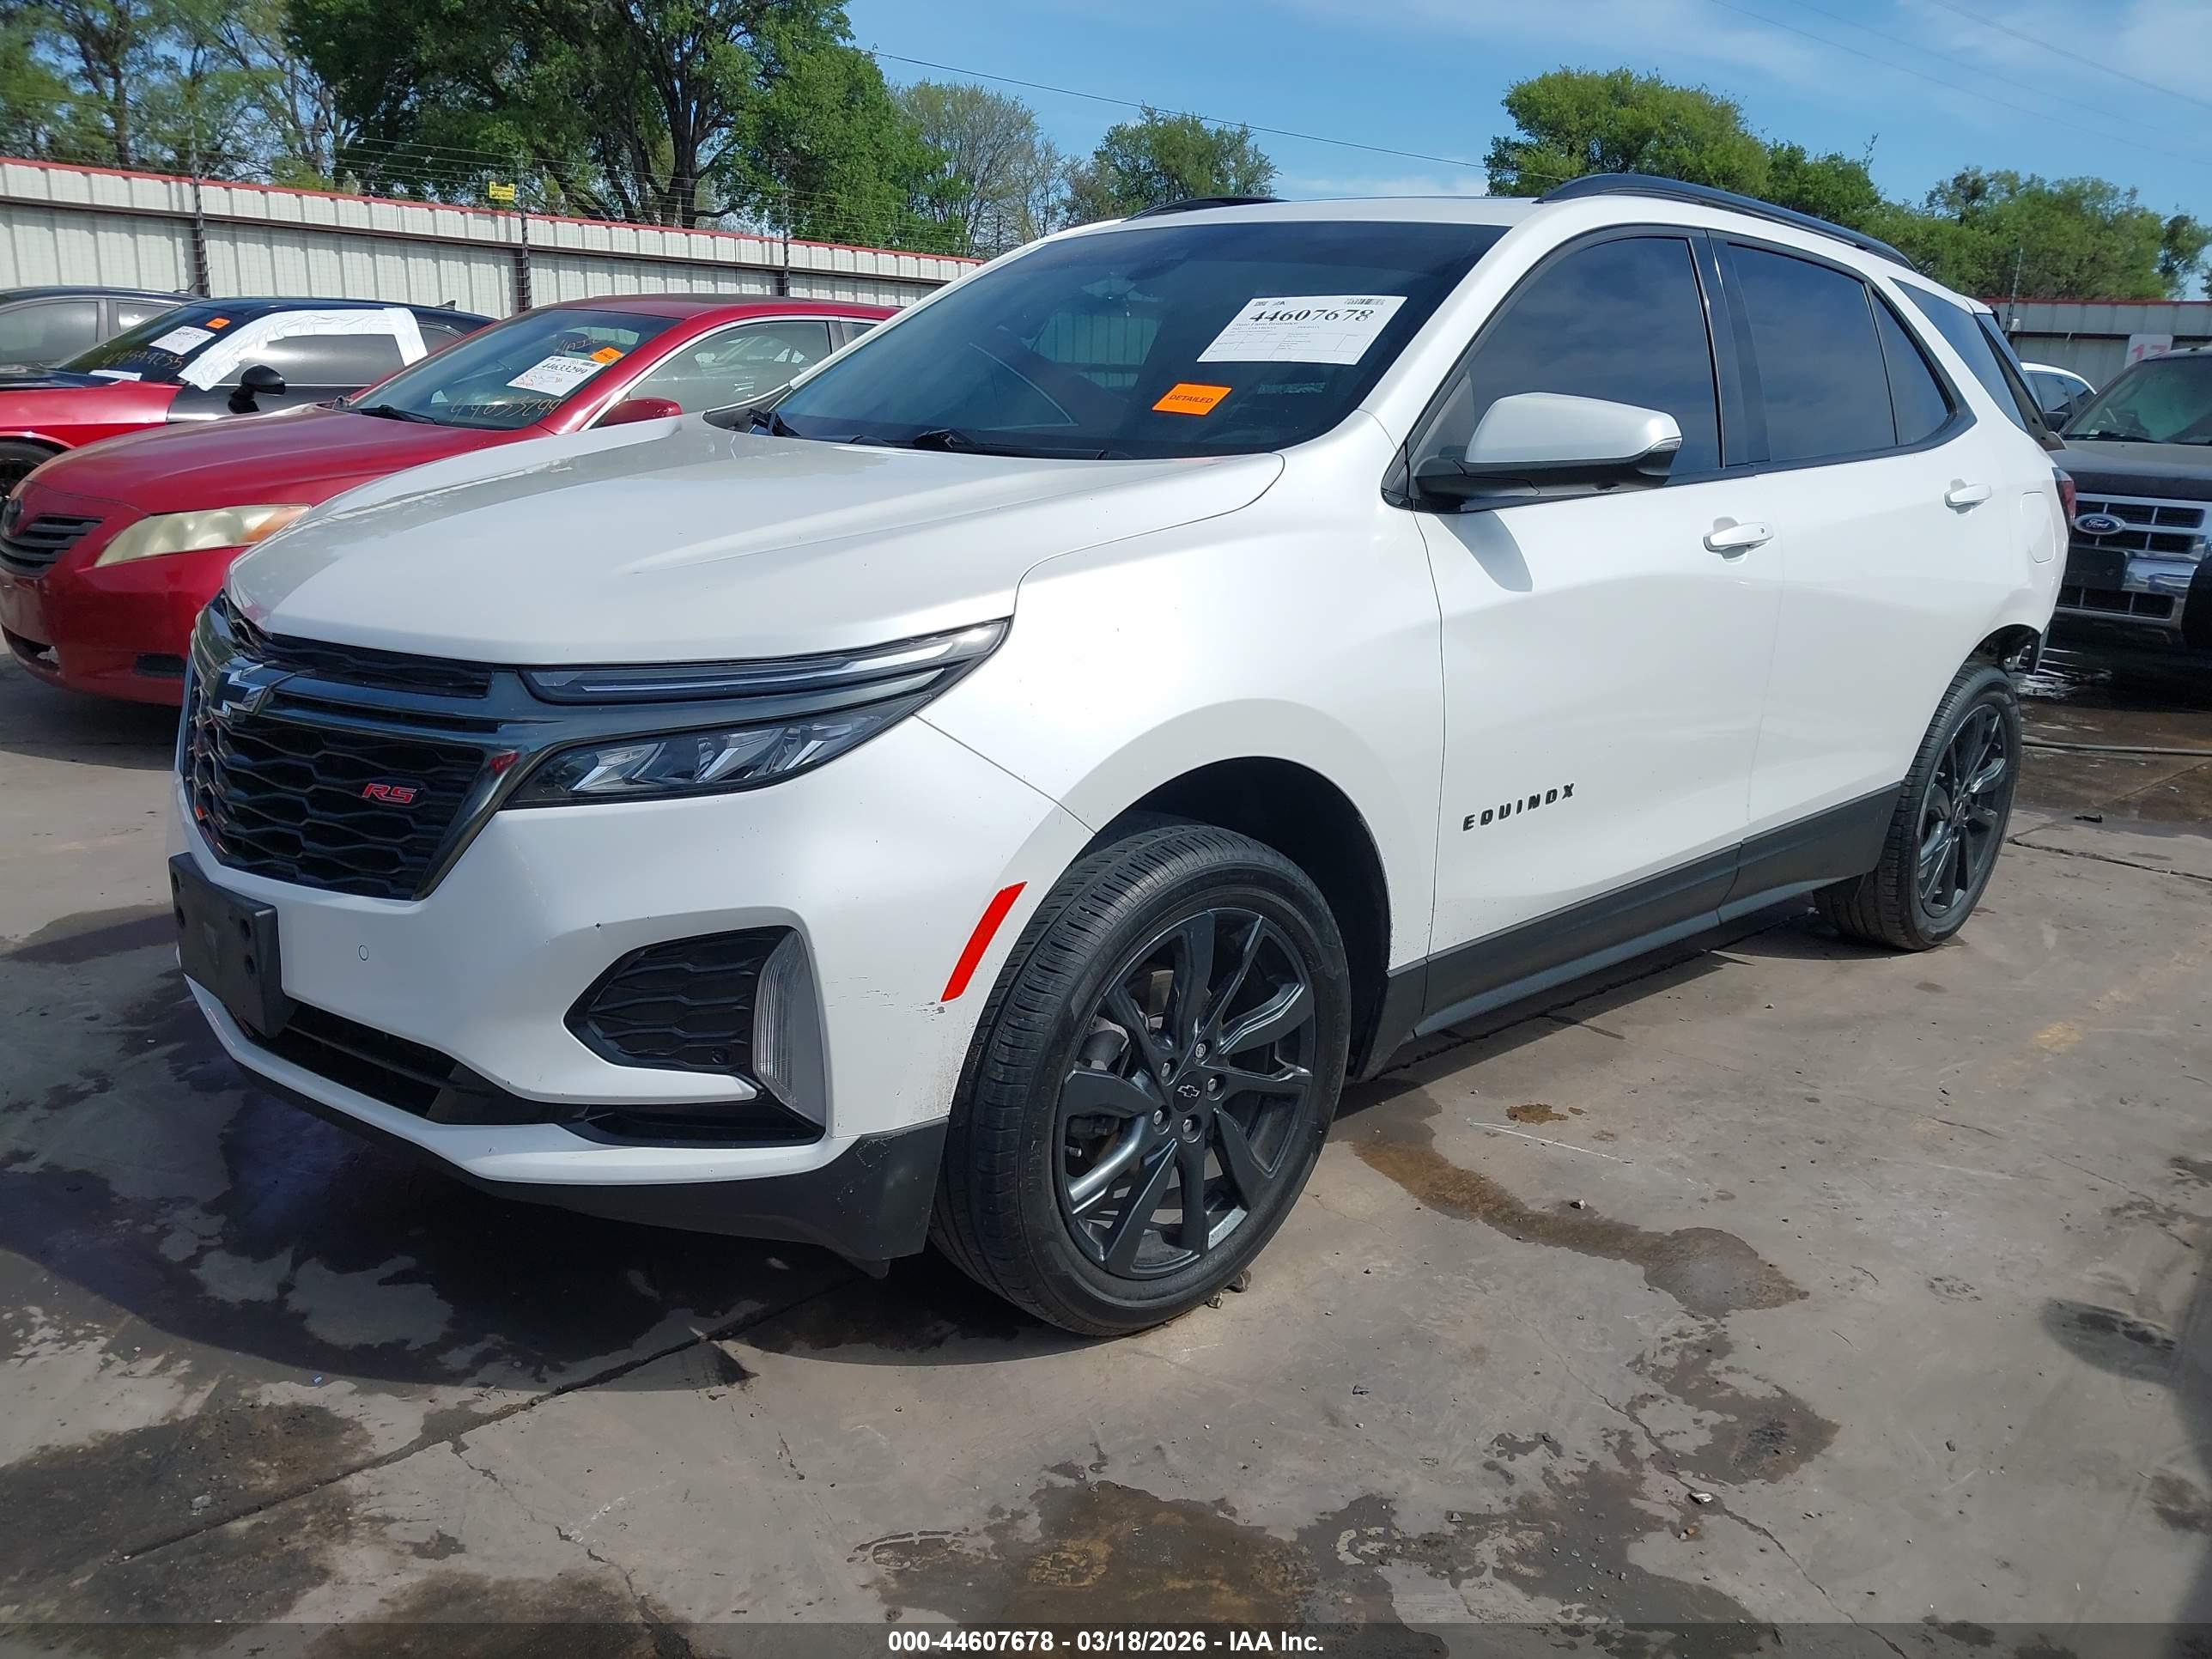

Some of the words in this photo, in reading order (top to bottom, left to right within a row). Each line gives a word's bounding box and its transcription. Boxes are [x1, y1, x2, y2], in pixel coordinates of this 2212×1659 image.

[1249, 308, 1375, 323] 44607678
[1169, 394, 1214, 404] DETAILED
[2086, 518, 2111, 530] Ford
[362, 782, 418, 804] RS
[1462, 782, 1575, 832] EQUINOX
